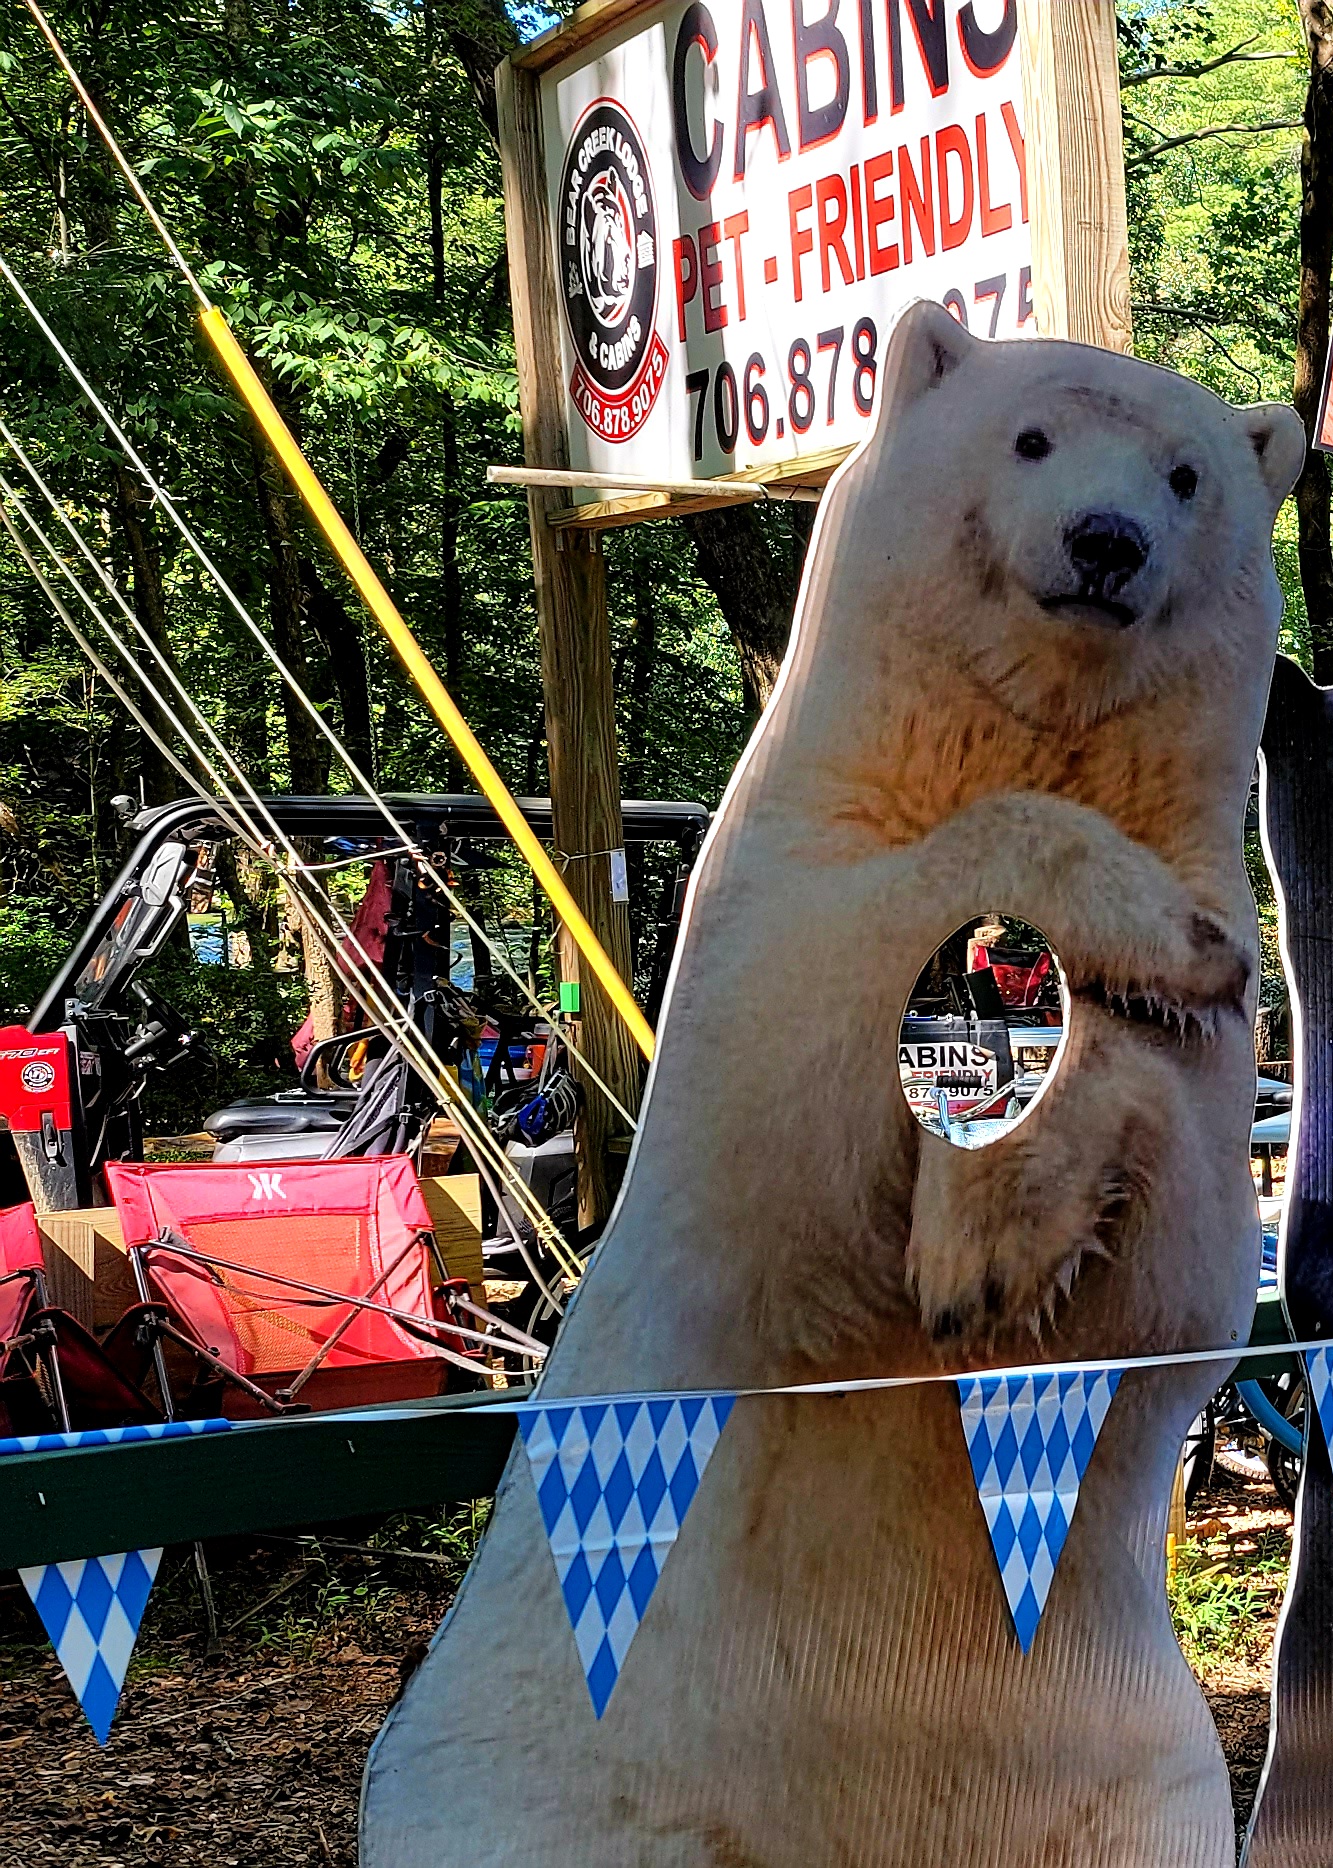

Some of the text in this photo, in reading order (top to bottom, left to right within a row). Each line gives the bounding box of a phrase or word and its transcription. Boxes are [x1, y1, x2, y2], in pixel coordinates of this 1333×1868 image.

[565, 126, 648, 246] BEAR CREEK LODGE
[672, 209, 751, 343] PET
[588, 313, 643, 372] & CABINS
[573, 347, 664, 436] 706.878.9075
[898, 1046, 989, 1069] ABINS
